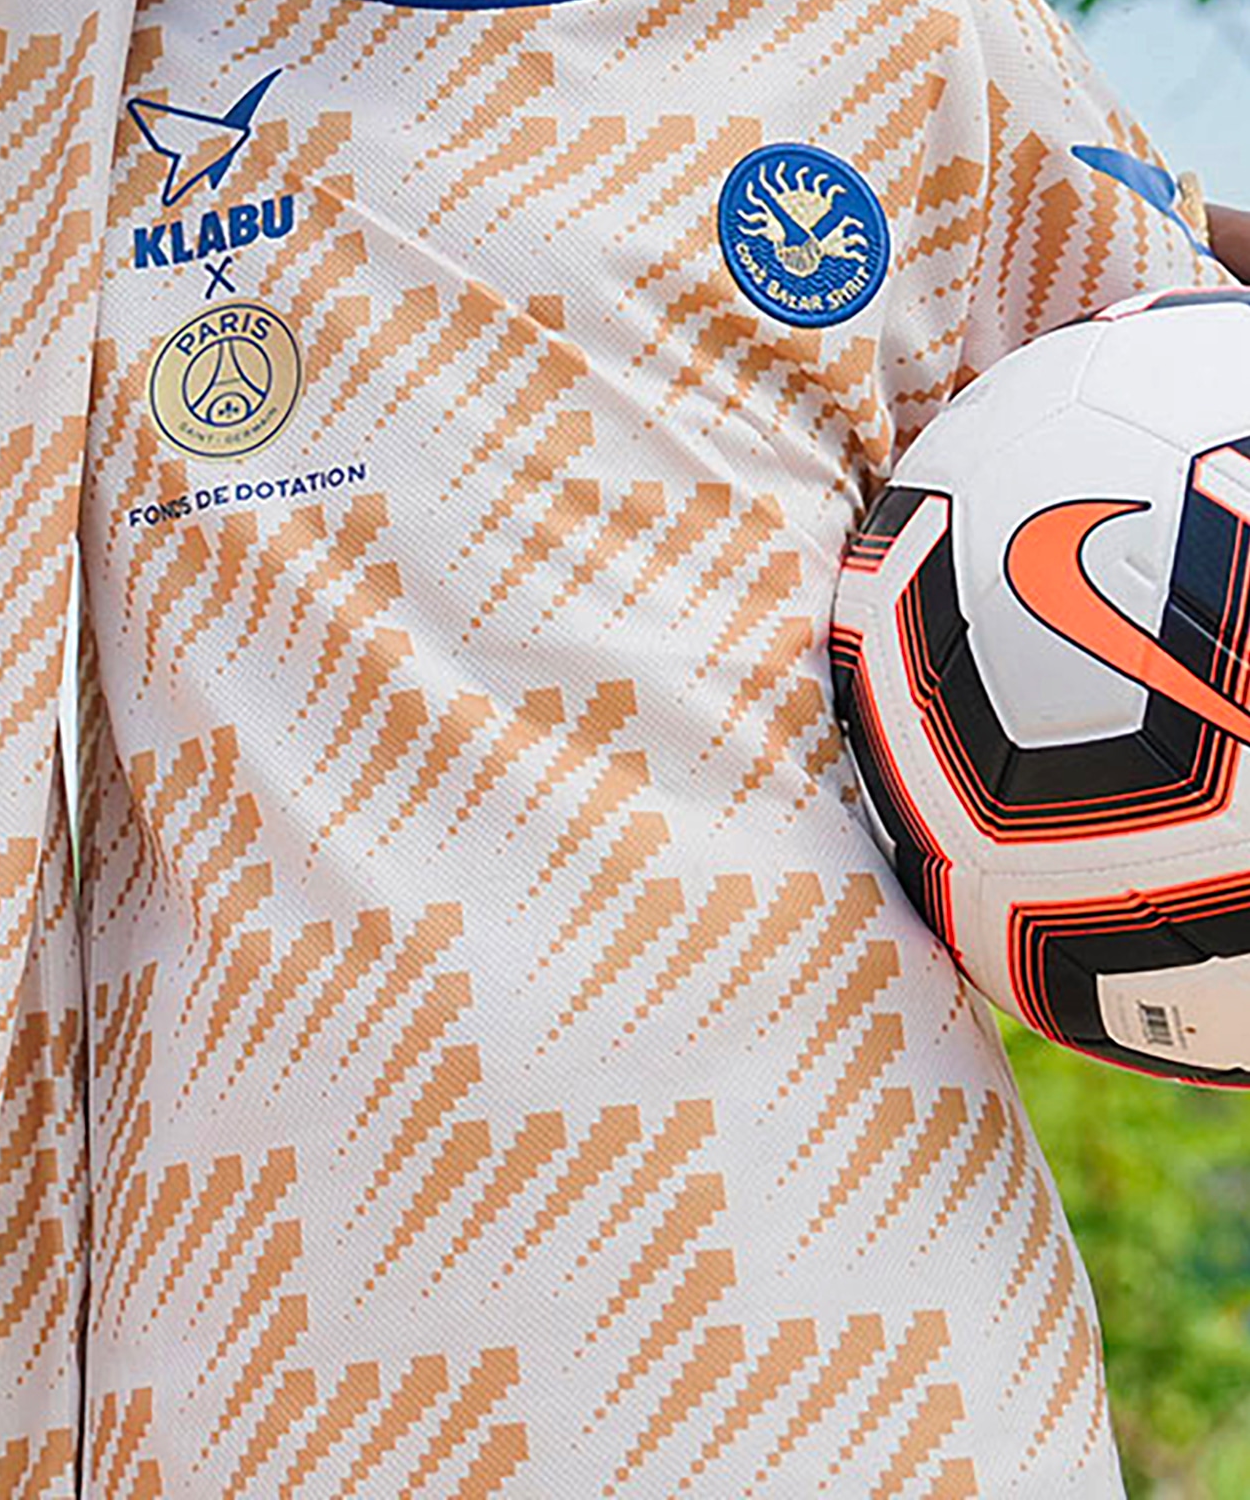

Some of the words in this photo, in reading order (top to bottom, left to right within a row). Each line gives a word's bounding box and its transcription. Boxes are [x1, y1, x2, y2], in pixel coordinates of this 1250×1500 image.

[134, 194, 294, 269] KLABU
[175, 312, 272, 356] PARIS
[129, 496, 192, 527] FONDS
[195, 486, 229, 510] DE
[235, 463, 366, 501] DOTATION
